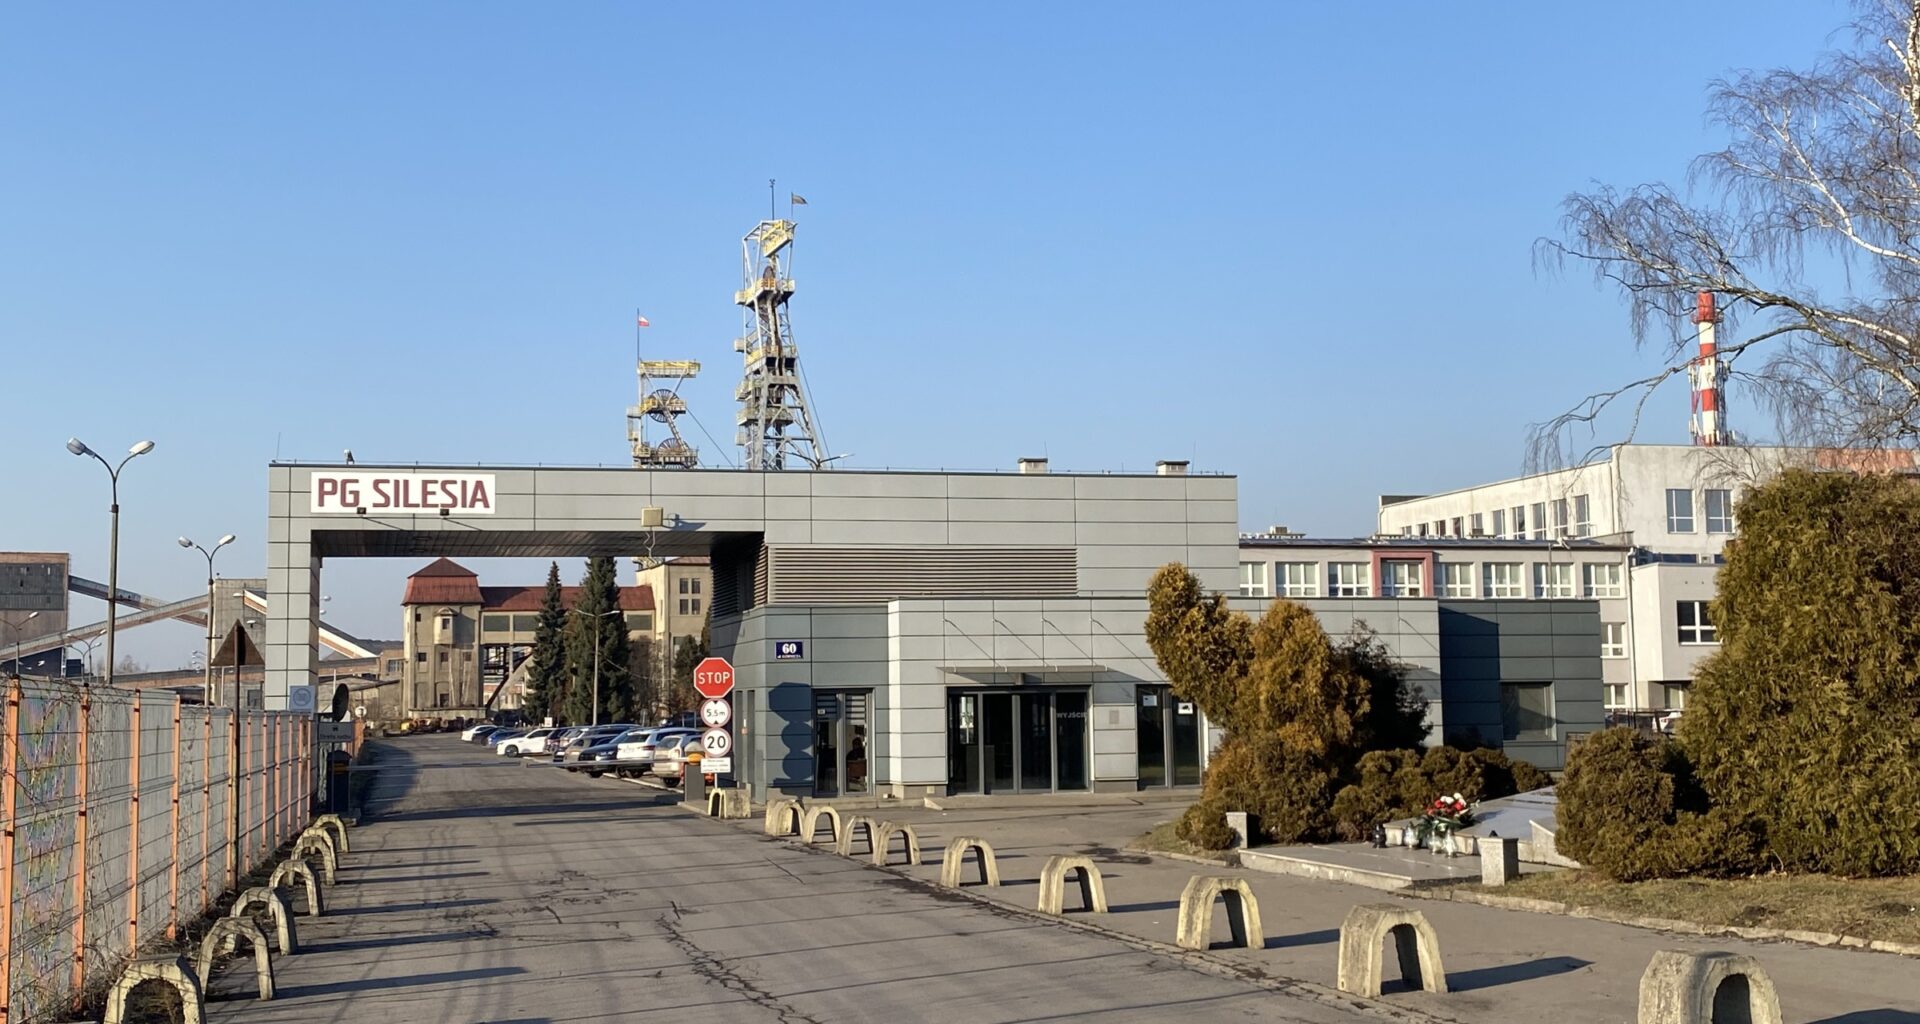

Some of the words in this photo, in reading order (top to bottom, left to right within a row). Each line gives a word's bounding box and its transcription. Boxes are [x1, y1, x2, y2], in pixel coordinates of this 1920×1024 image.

[318, 478, 360, 507] PG
[372, 479, 490, 509] SILESIA
[782, 642, 797, 654] 60
[698, 671, 731, 685] STOP
[707, 735, 726, 749] 20
